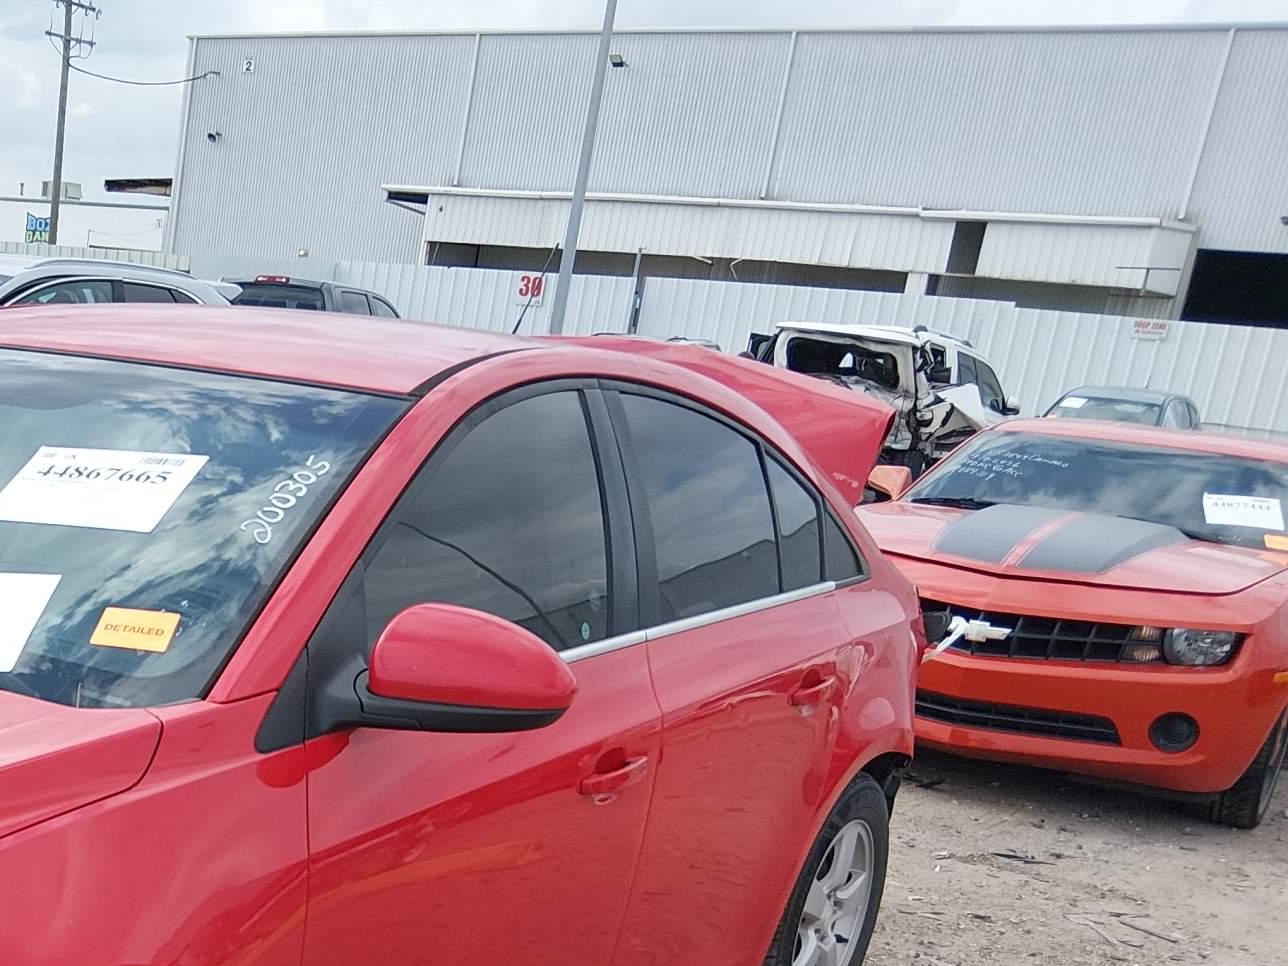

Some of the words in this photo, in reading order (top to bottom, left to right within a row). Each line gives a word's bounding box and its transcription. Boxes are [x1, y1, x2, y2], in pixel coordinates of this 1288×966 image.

[245, 60, 253, 72] 2
[518, 275, 543, 297] 30
[37, 464, 173, 484] 44867665
[239, 454, 330, 544] 200305
[103, 623, 165, 637] DETAILED
